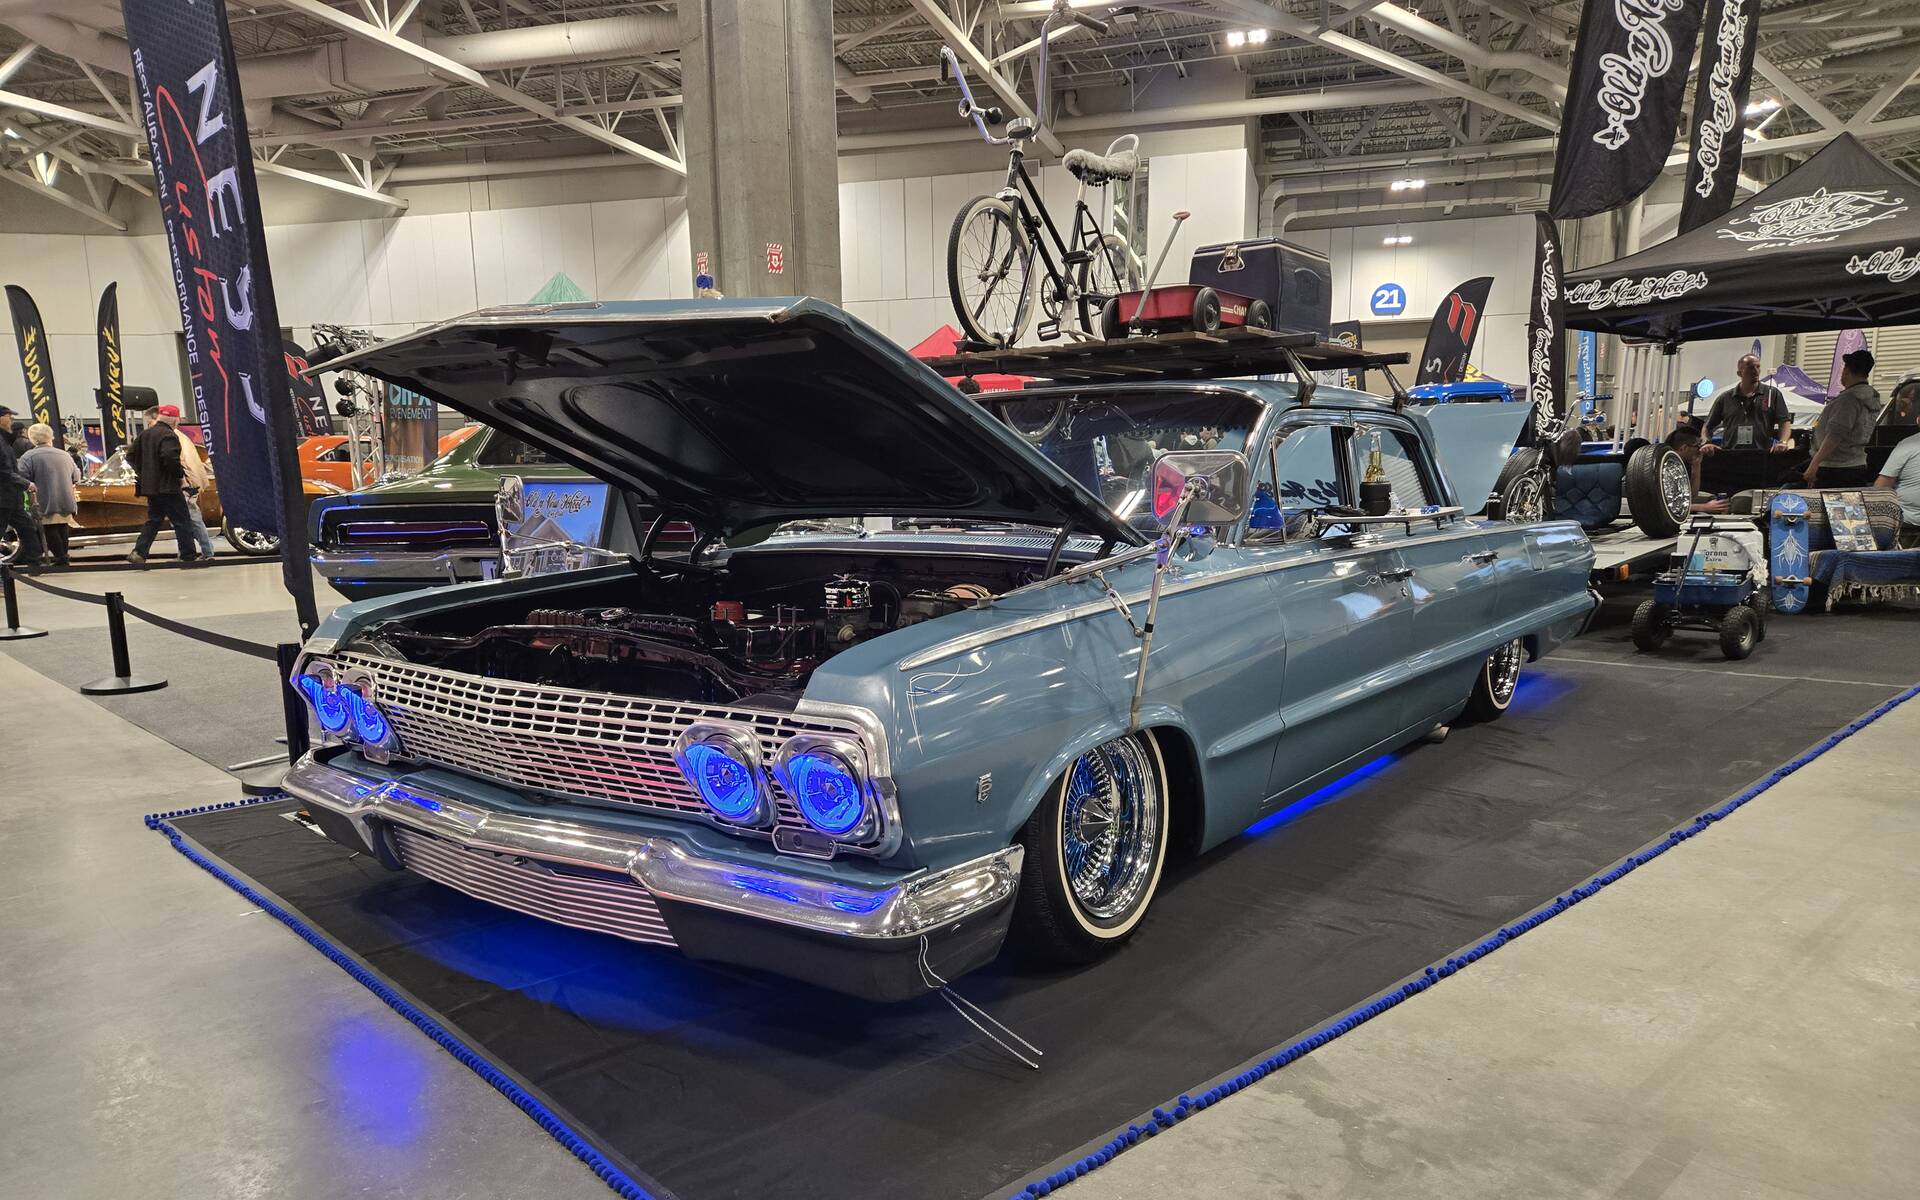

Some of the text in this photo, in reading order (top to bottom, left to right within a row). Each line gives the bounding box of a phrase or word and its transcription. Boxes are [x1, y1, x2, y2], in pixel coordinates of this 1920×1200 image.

[156, 84, 230, 455] Custom
[1375, 290, 1402, 309] 21
[1569, 279, 1602, 304] Old
[1641, 270, 1698, 299] School
[167, 219, 200, 365] PERFORMANCE
[193, 385, 215, 456] DESIGN
